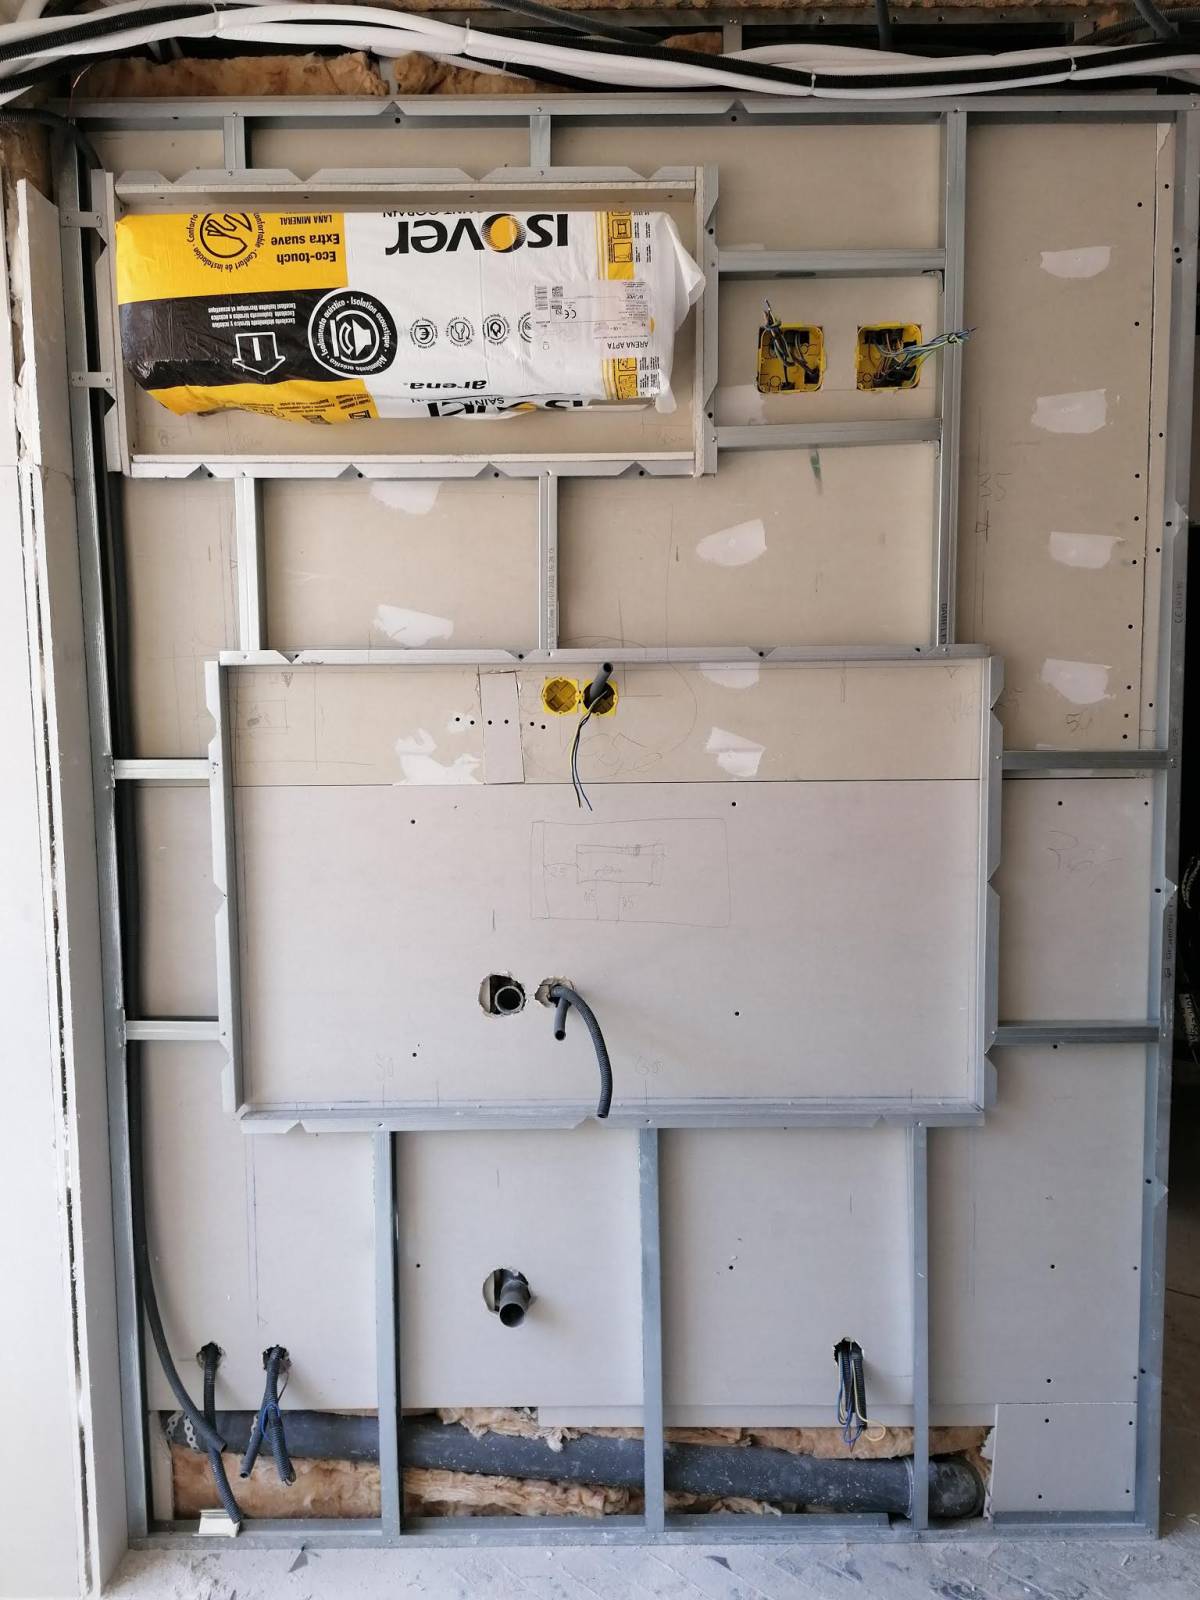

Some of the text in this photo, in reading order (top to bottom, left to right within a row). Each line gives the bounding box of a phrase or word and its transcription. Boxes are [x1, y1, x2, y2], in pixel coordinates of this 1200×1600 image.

[280, 215, 333, 226] LANA MINERAL
[253, 213, 266, 249] onfortable
[271, 233, 340, 246] Extra suave
[277, 251, 336, 265] Eco-touch
[225, 264, 233, 272] de
[607, 341, 649, 350] ARENA APTA
